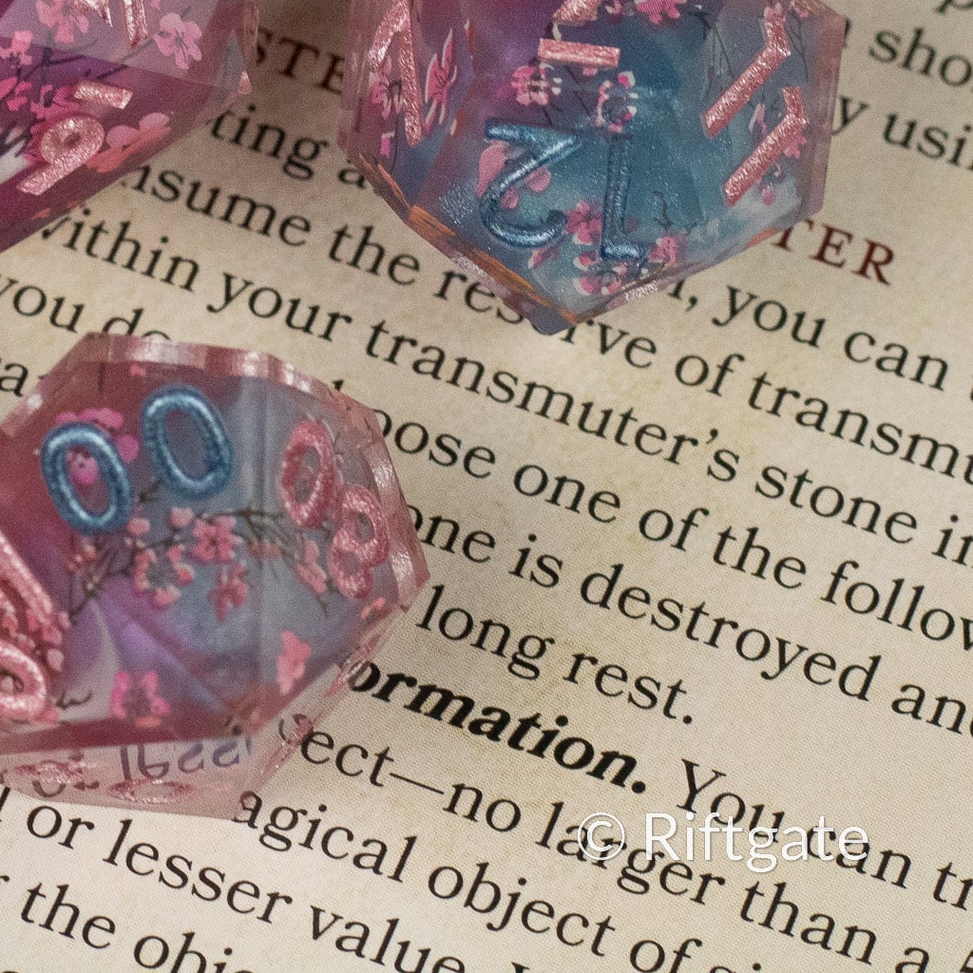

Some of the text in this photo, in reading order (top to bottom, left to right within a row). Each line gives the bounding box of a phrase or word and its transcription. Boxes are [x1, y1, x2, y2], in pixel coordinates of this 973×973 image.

[328, 225, 422, 288] the
[673, 352, 747, 398] of
[711, 286, 828, 350] you
[842, 330, 951, 393] can
[39, 383, 234, 535] 00
[206, 272, 355, 343] your
[753, 464, 920, 546] stone
[512, 463, 623, 526] one
[637, 506, 712, 553] of
[712, 526, 809, 592] the
[416, 583, 695, 727] long rest.
[509, 533, 884, 704] is destroyed
[26, 806, 97, 851] or
[103, 819, 294, 926] lesser
[677, 758, 787, 845] You
[20, 882, 118, 952] the
[426, 861, 617, 959] object
[534, 801, 727, 907] larger
[739, 881, 879, 967] than
